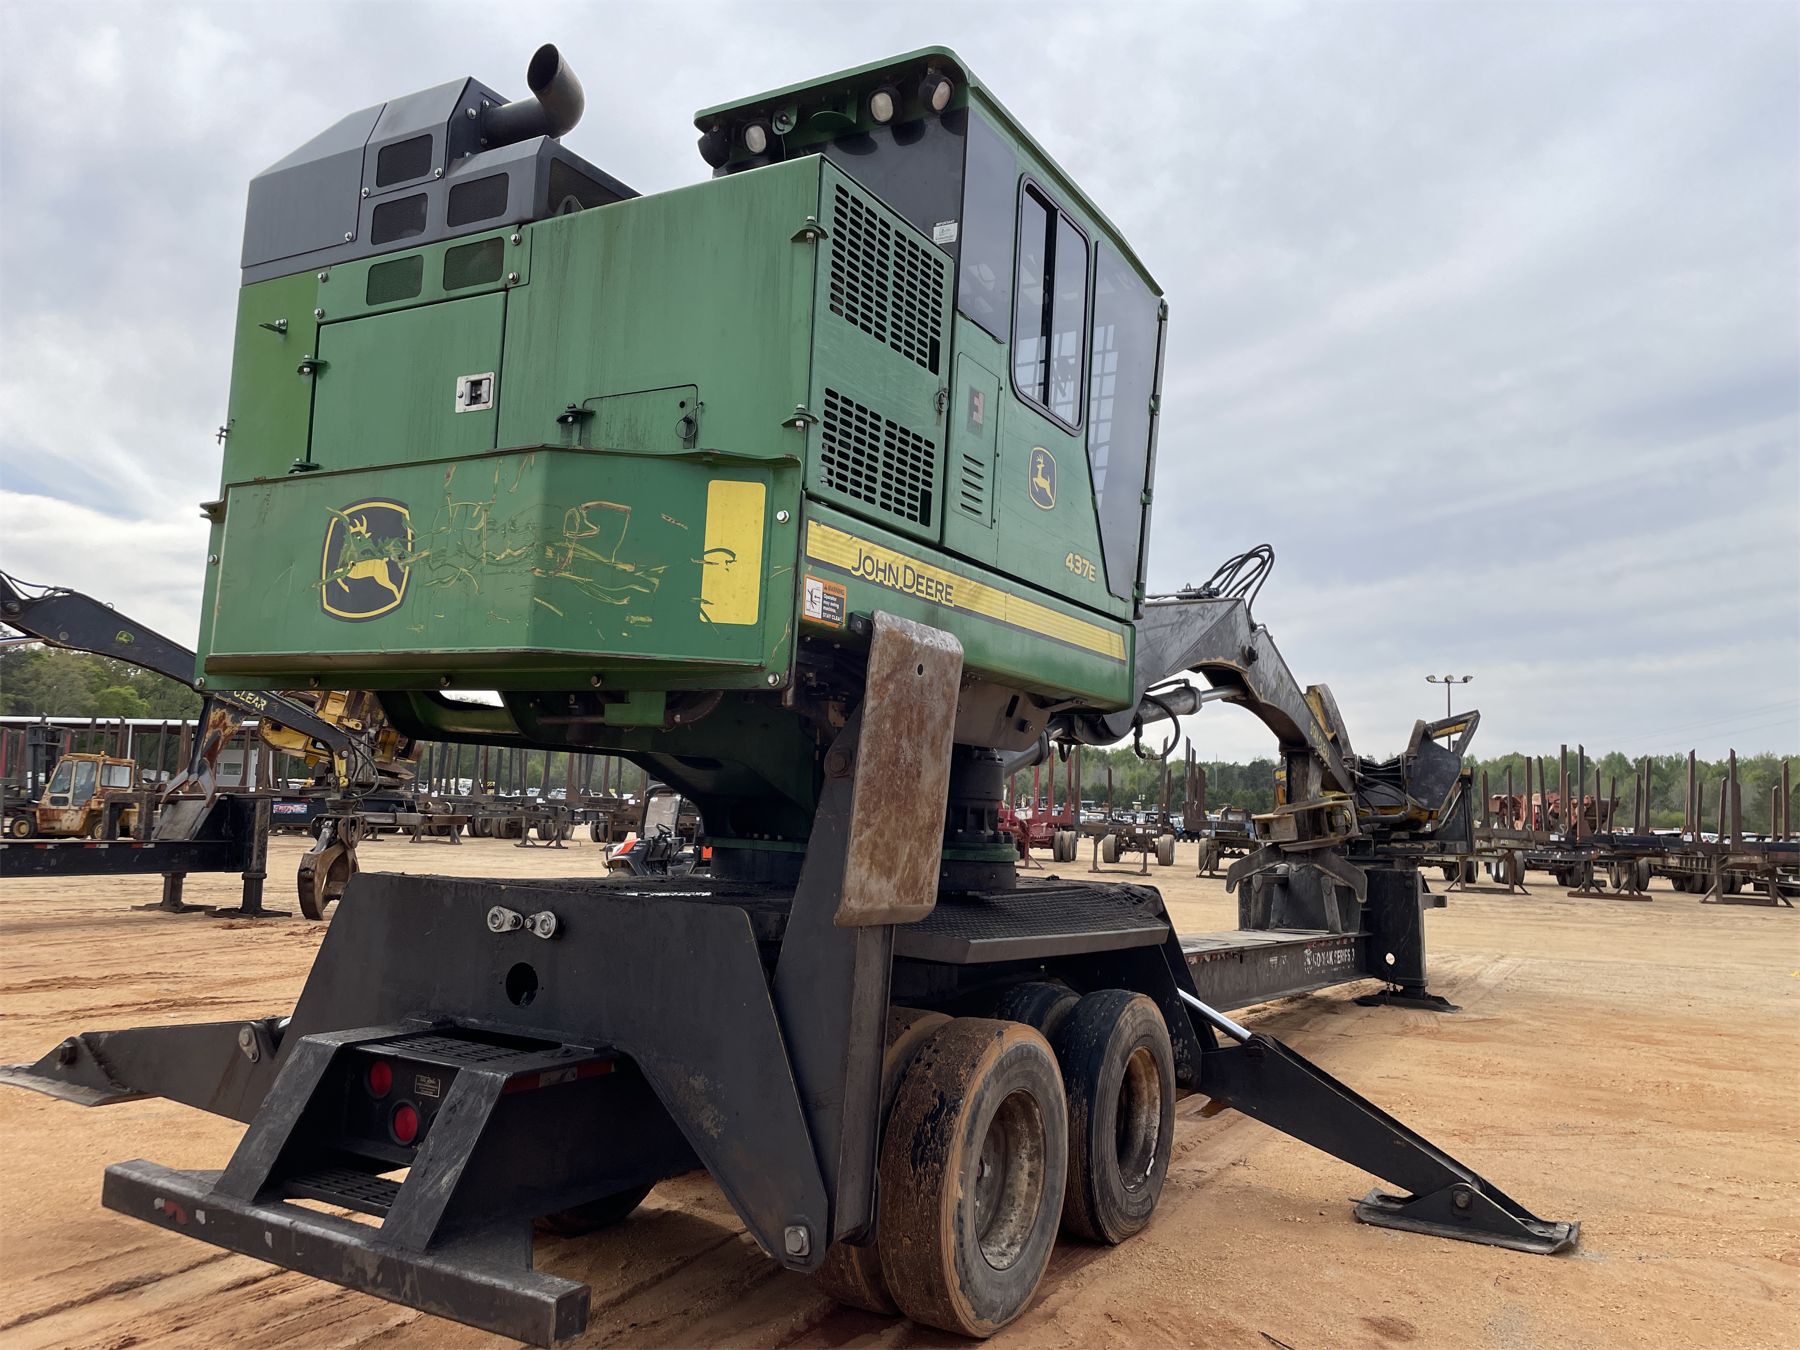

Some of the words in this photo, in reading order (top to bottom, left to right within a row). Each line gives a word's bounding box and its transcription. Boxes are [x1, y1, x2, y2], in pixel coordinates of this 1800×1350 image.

[851, 547, 899, 586] JOHN
[903, 564, 954, 604] DEERE
[1065, 552, 1096, 582] 437E
[233, 690, 267, 711] CLEAR
